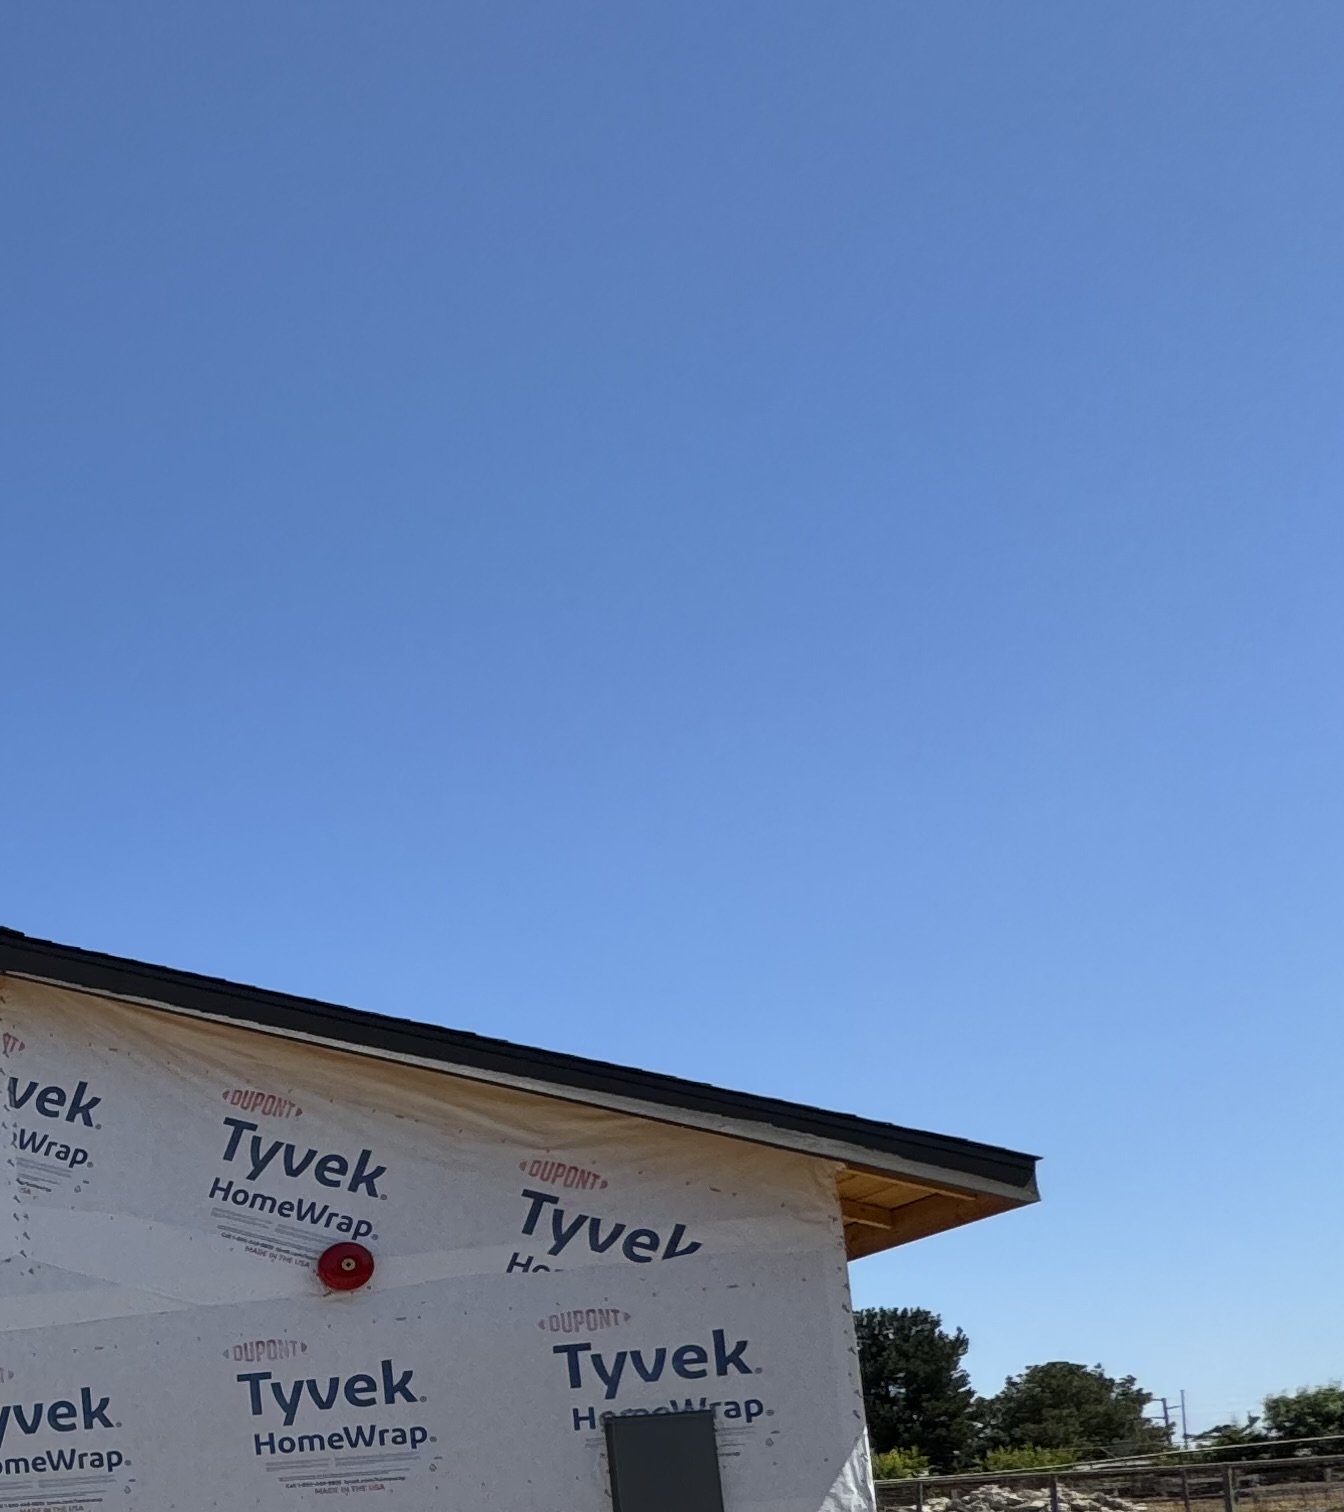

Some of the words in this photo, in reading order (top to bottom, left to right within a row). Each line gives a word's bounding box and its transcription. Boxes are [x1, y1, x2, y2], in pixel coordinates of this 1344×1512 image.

[8, 1077, 102, 1127] vek
[231, 1089, 296, 1118] DUPONT
[14, 1128, 88, 1168] Wrap
[223, 1117, 387, 1198] Tyvek
[528, 1160, 600, 1190] DUPONT
[209, 1177, 373, 1240] HomeWrap
[548, 1308, 620, 1332] DUPONT
[233, 1339, 298, 1362] DUPONT
[553, 1329, 753, 1400] Tyvek
[237, 1359, 417, 1426] Tyvek
[254, 1424, 428, 1455] HomeWrap
